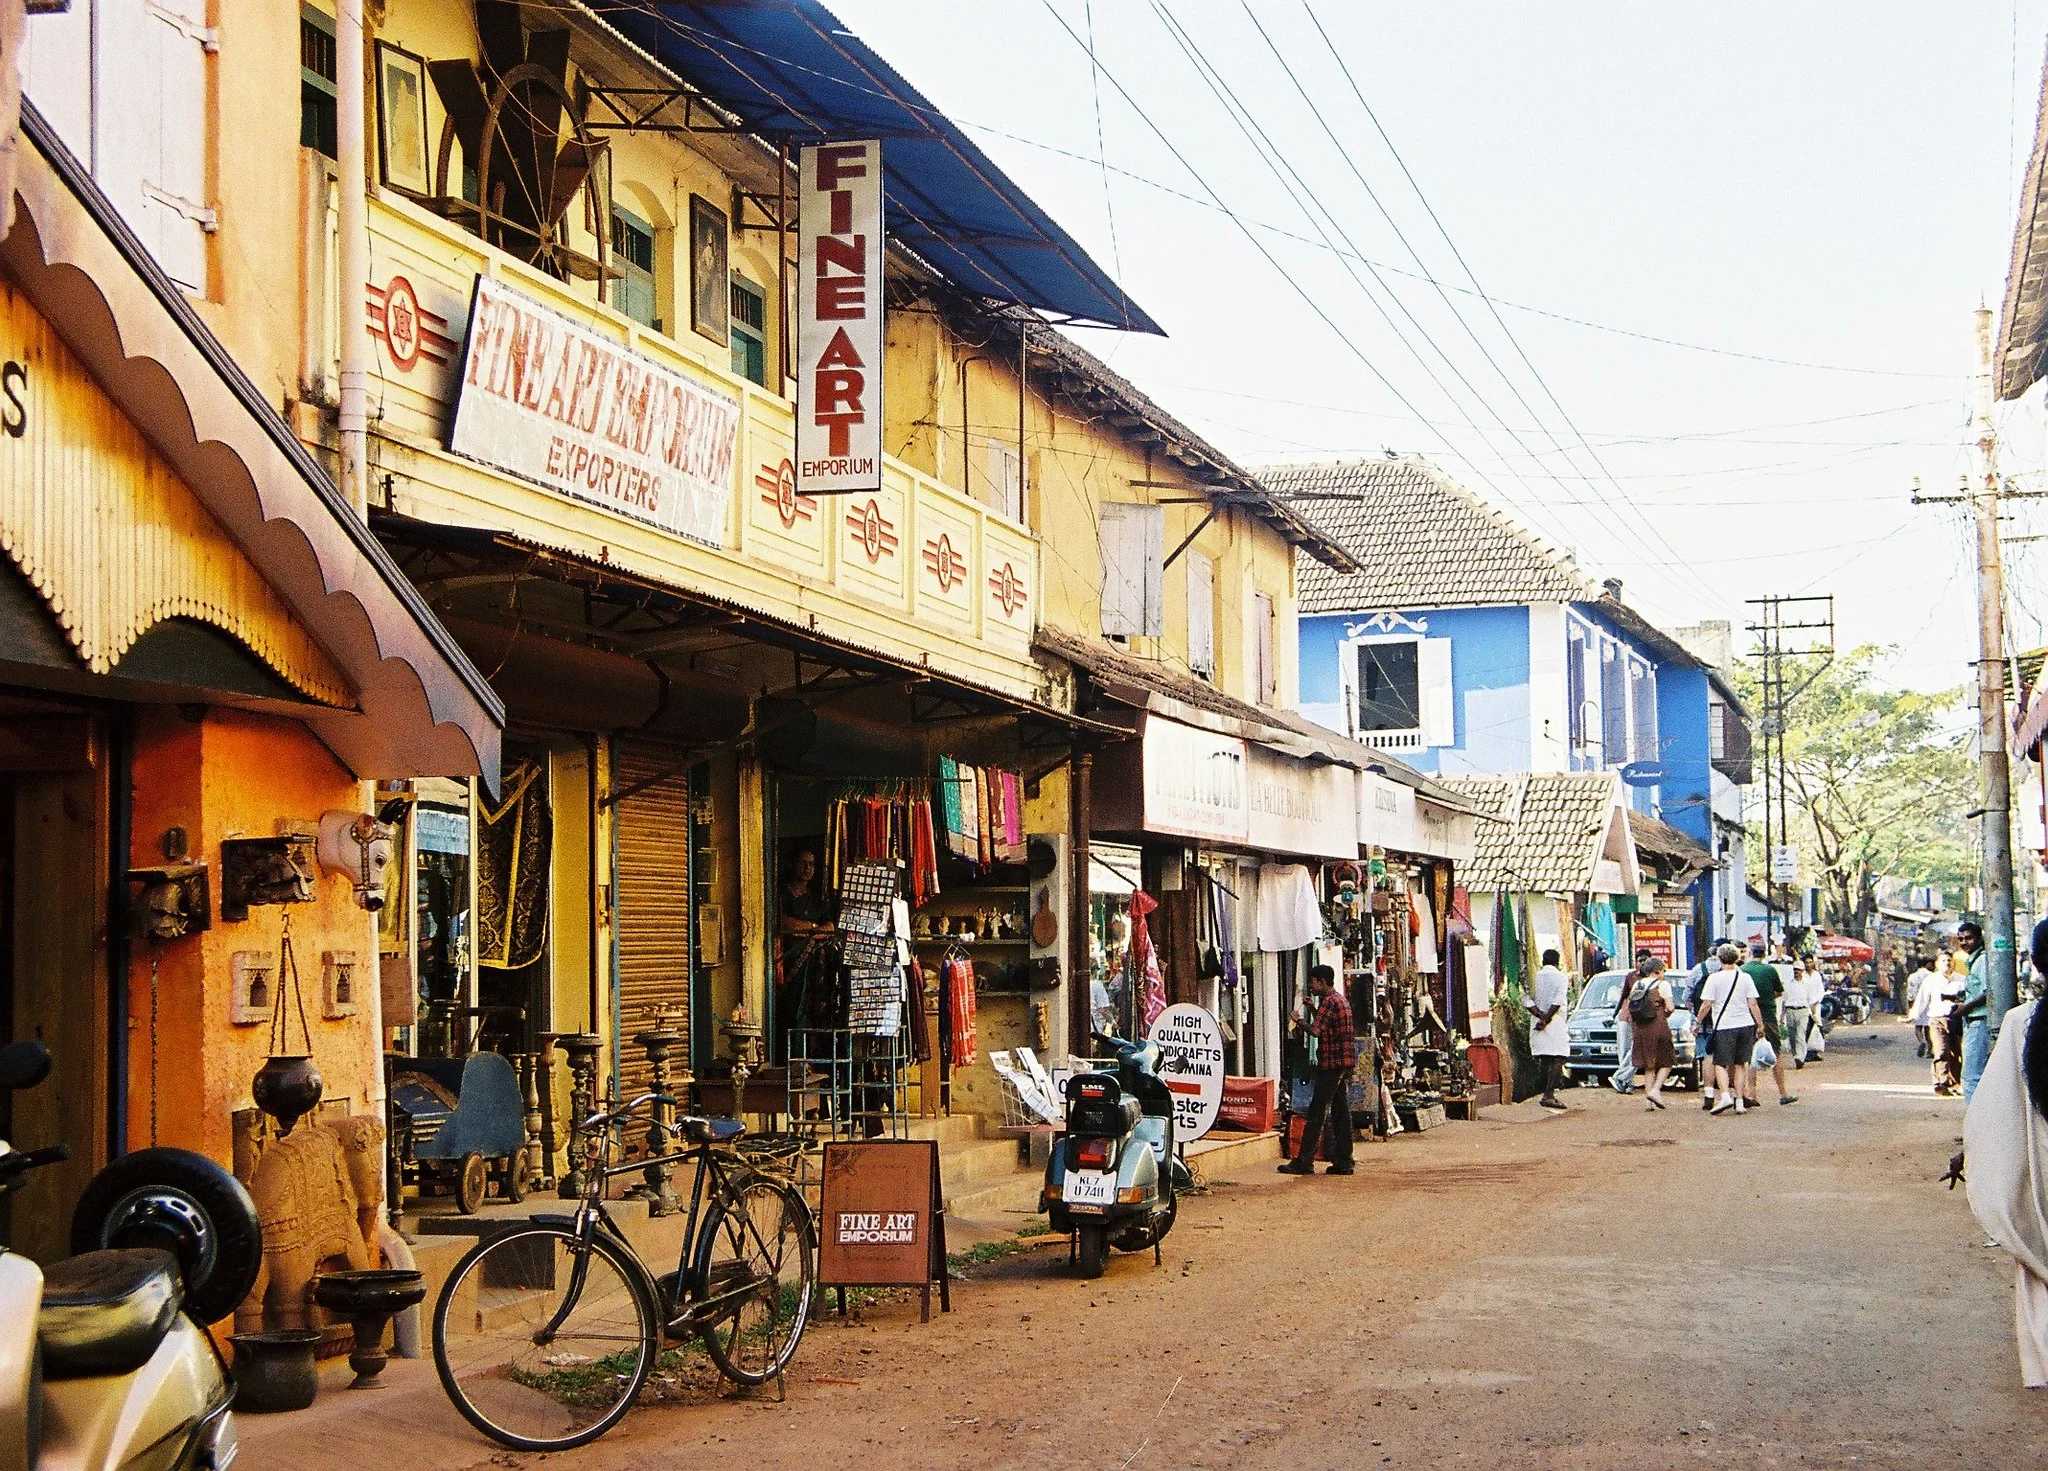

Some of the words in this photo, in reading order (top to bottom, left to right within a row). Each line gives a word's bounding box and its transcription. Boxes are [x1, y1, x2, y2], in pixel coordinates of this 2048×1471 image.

[816, 145, 866, 321] FINE
[467, 292, 549, 413] FINE
[543, 330, 615, 435] ART
[606, 354, 738, 488] EMPORIUM
[815, 325, 866, 457] ART
[545, 436, 662, 512] EXPORTERS
[802, 457, 873, 478] EMPORIUM
[1173, 1015, 1202, 1029] HIGH
[1158, 1029, 1212, 1045] QUALITY
[1163, 1045, 1222, 1062] NDICRAFTS
[1173, 1098, 1208, 1114] ster
[1079, 1176, 1091, 1185] KL
[1094, 1177, 1100, 1185] 7
[1074, 1185, 1082, 1196] U
[839, 1213, 881, 1230] FINE
[883, 1213, 915, 1230] ART
[839, 1230, 913, 1242] EMPORIUM
